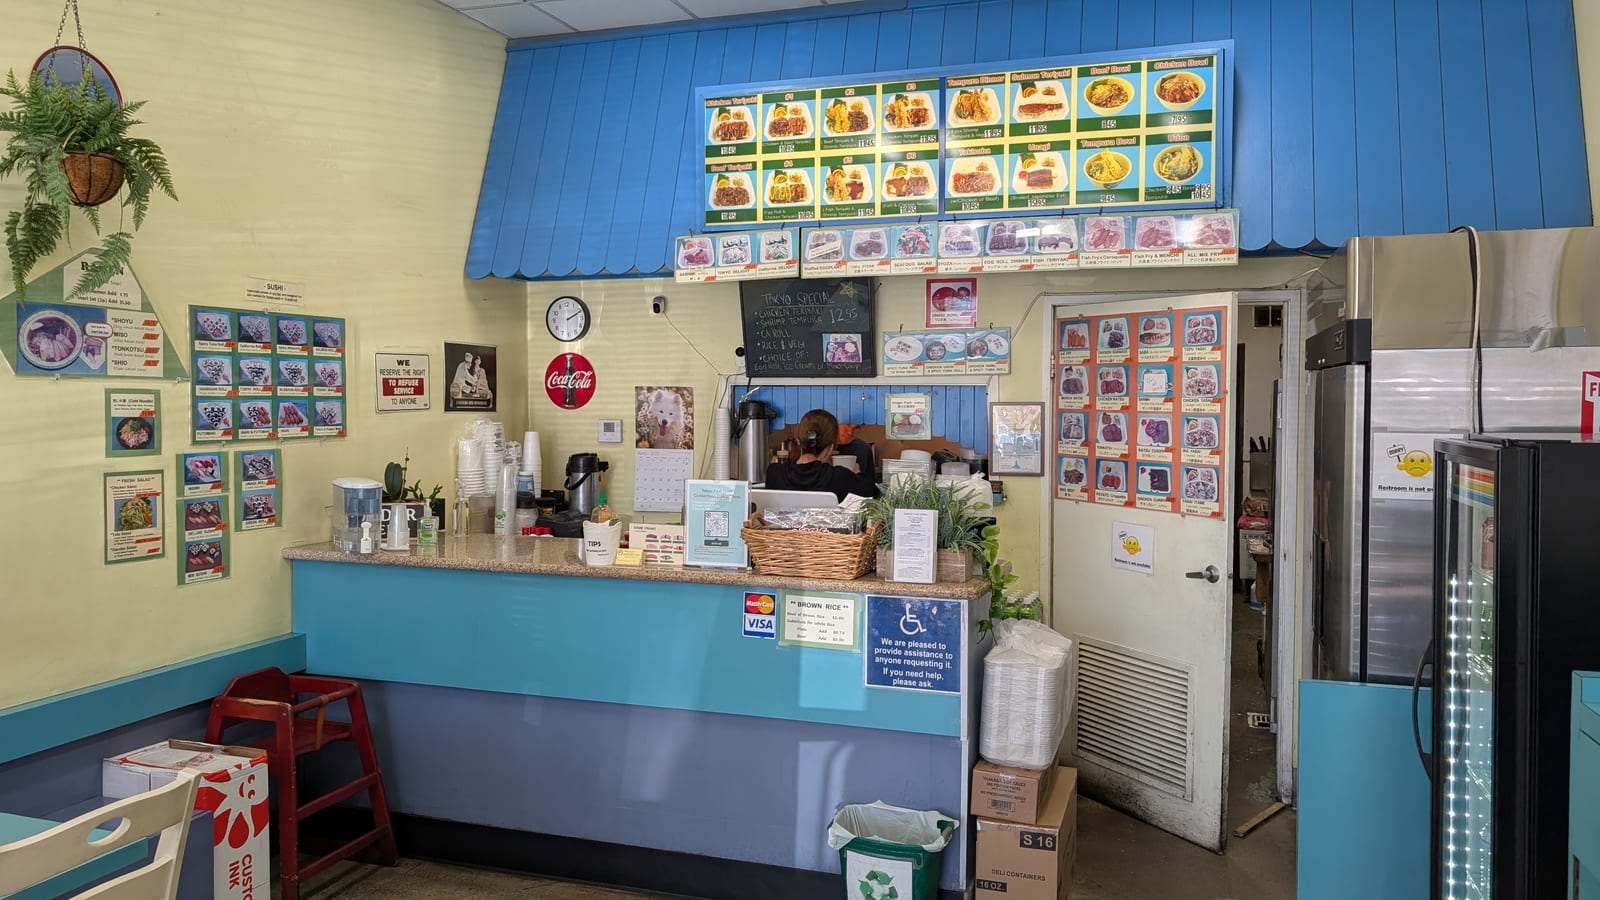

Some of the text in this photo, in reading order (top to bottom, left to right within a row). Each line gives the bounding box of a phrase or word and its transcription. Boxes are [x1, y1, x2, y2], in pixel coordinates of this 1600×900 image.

[1154, 61, 1186, 69] Chicken
[1041, 70, 1070, 78] Teriyaki
[727, 163, 752, 172] Teriyaki
[761, 291, 835, 305] TOKYO SPECIAL
[760, 308, 789, 318] CHICKEN
[762, 341, 778, 349] RICE
[763, 352, 792, 362] CHOICE
[548, 371, 593, 389] Coca-Cola
[748, 618, 773, 629] VISA
[908, 640, 936, 649] pleased
[874, 647, 902, 655] provide
[904, 649, 943, 658] assistance
[904, 658, 944, 669] requesting
[925, 671, 944, 680] help,
[893, 678, 916, 686] please
[1023, 834, 1053, 848] S 16
[229, 861, 240, 889] INK
[241, 854, 253, 900] CUSTO
[1007, 871, 1046, 881] CONTAINERS
